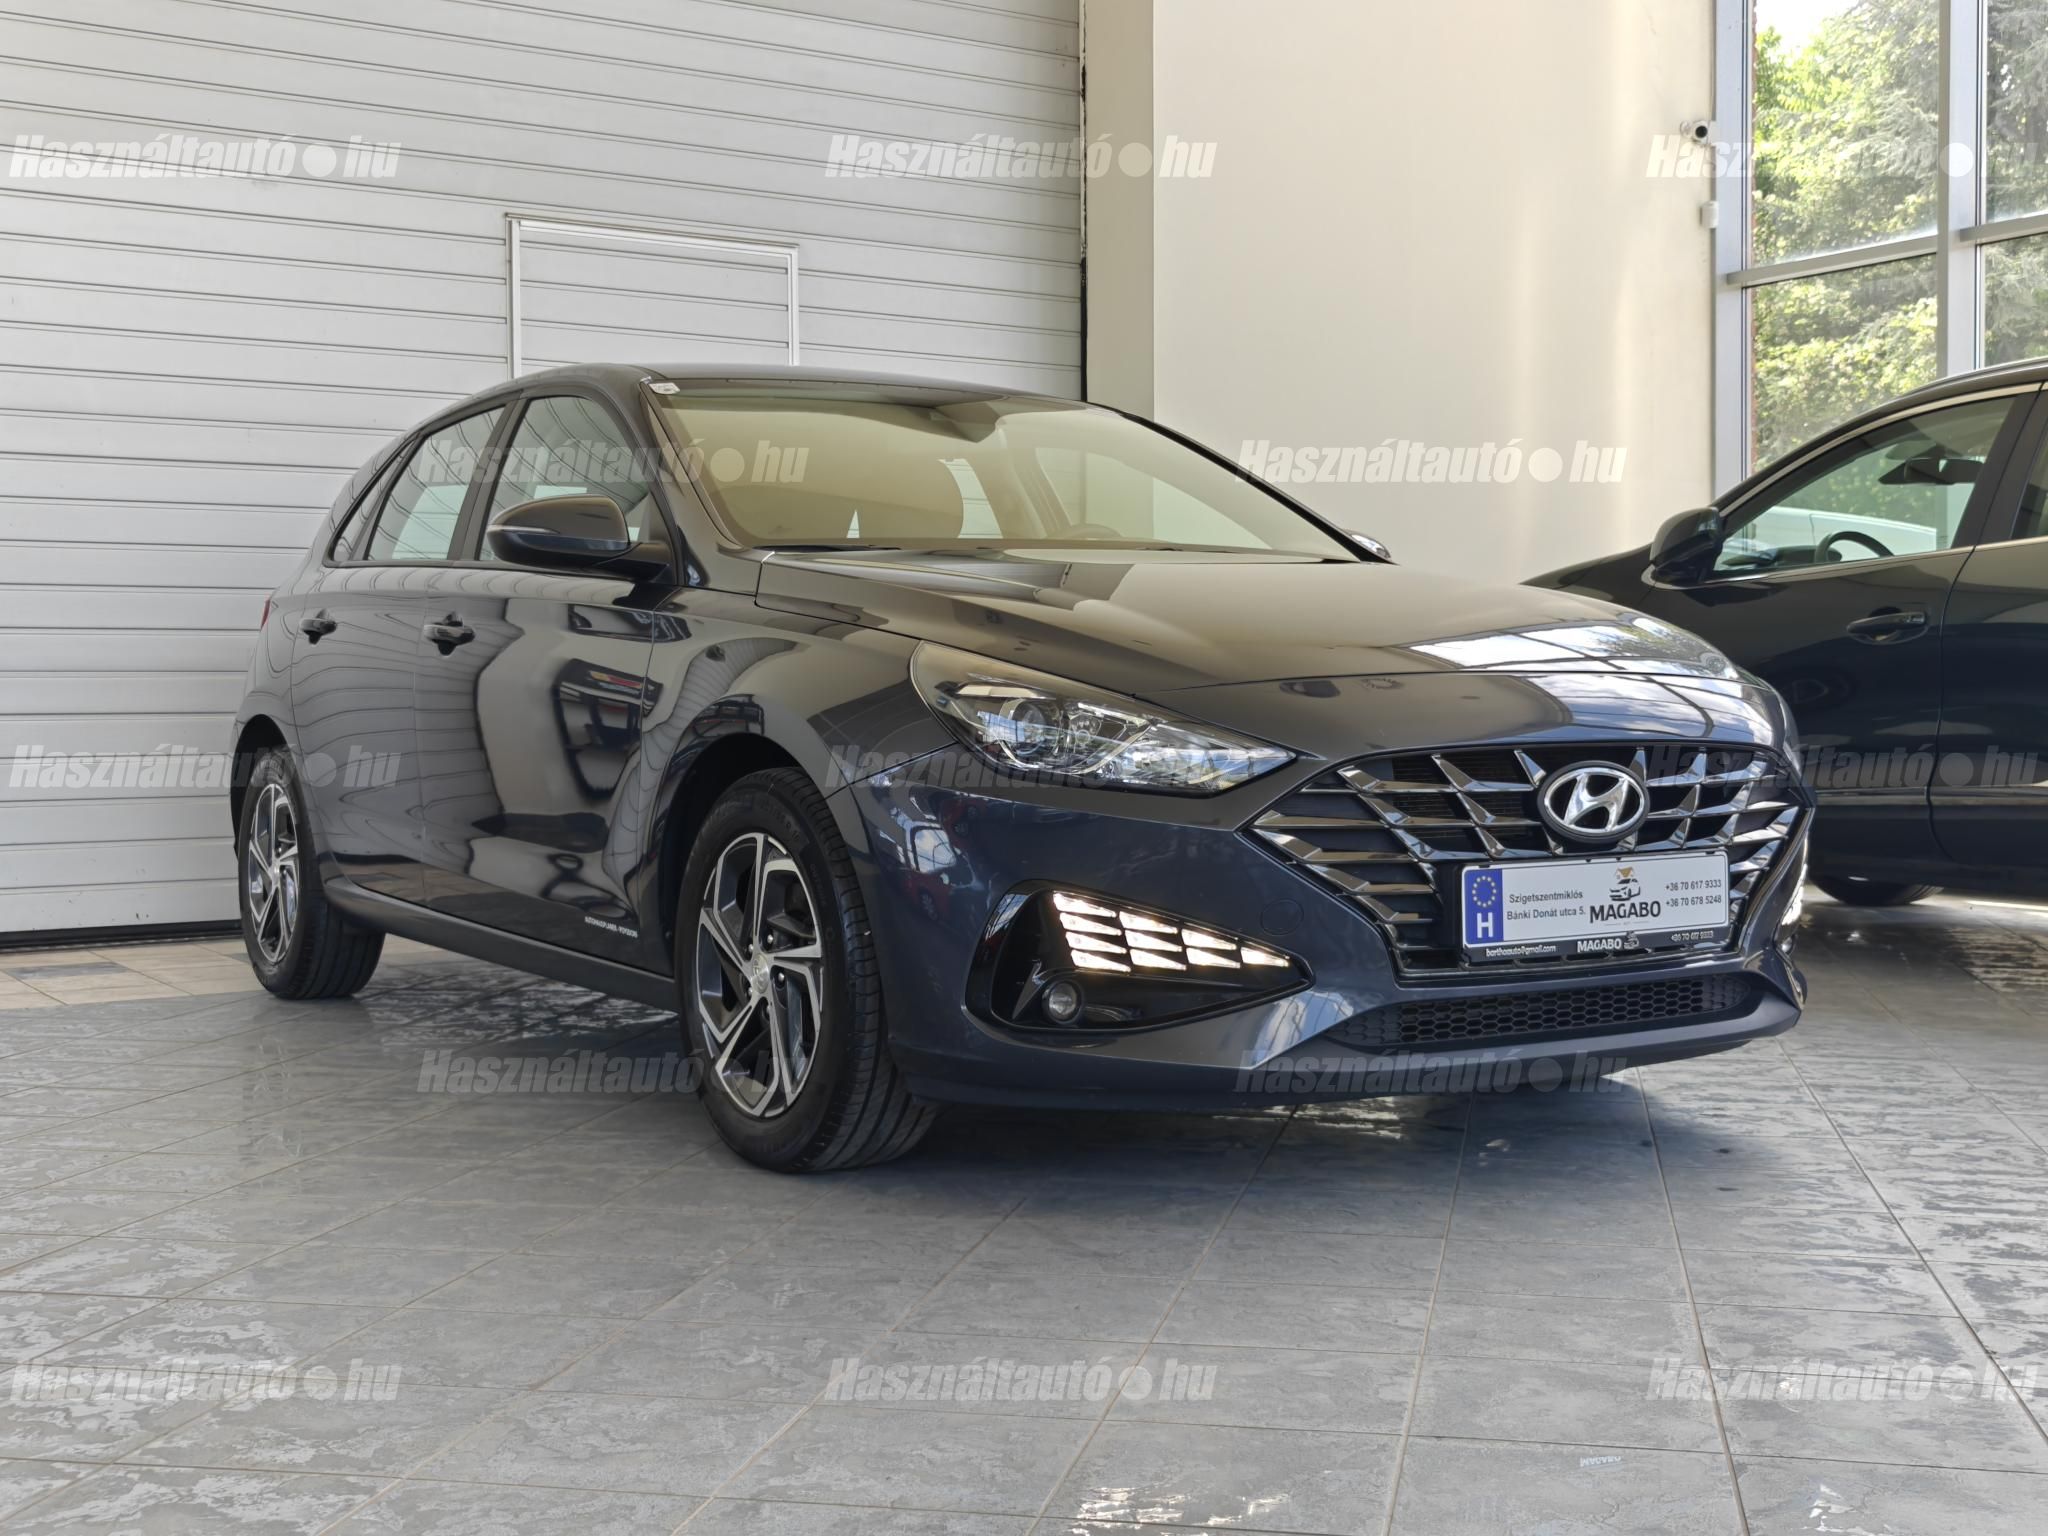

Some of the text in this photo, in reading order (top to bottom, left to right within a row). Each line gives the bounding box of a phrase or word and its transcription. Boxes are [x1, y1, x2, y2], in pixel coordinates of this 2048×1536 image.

[1665, 879, 1722, 891] +36 70 617 9333
[1509, 890, 1584, 905] Szigetszentmiklós
[1665, 895, 1722, 907] +36 70 678 5248
[1507, 909, 1531, 921] Bánki
[1533, 908, 1558, 919] Donát
[1559, 907, 1577, 917] utca
[1589, 900, 1662, 924] MAGABO
[1476, 912, 1494, 938] H
[1577, 938, 1622, 953] MAGABO
